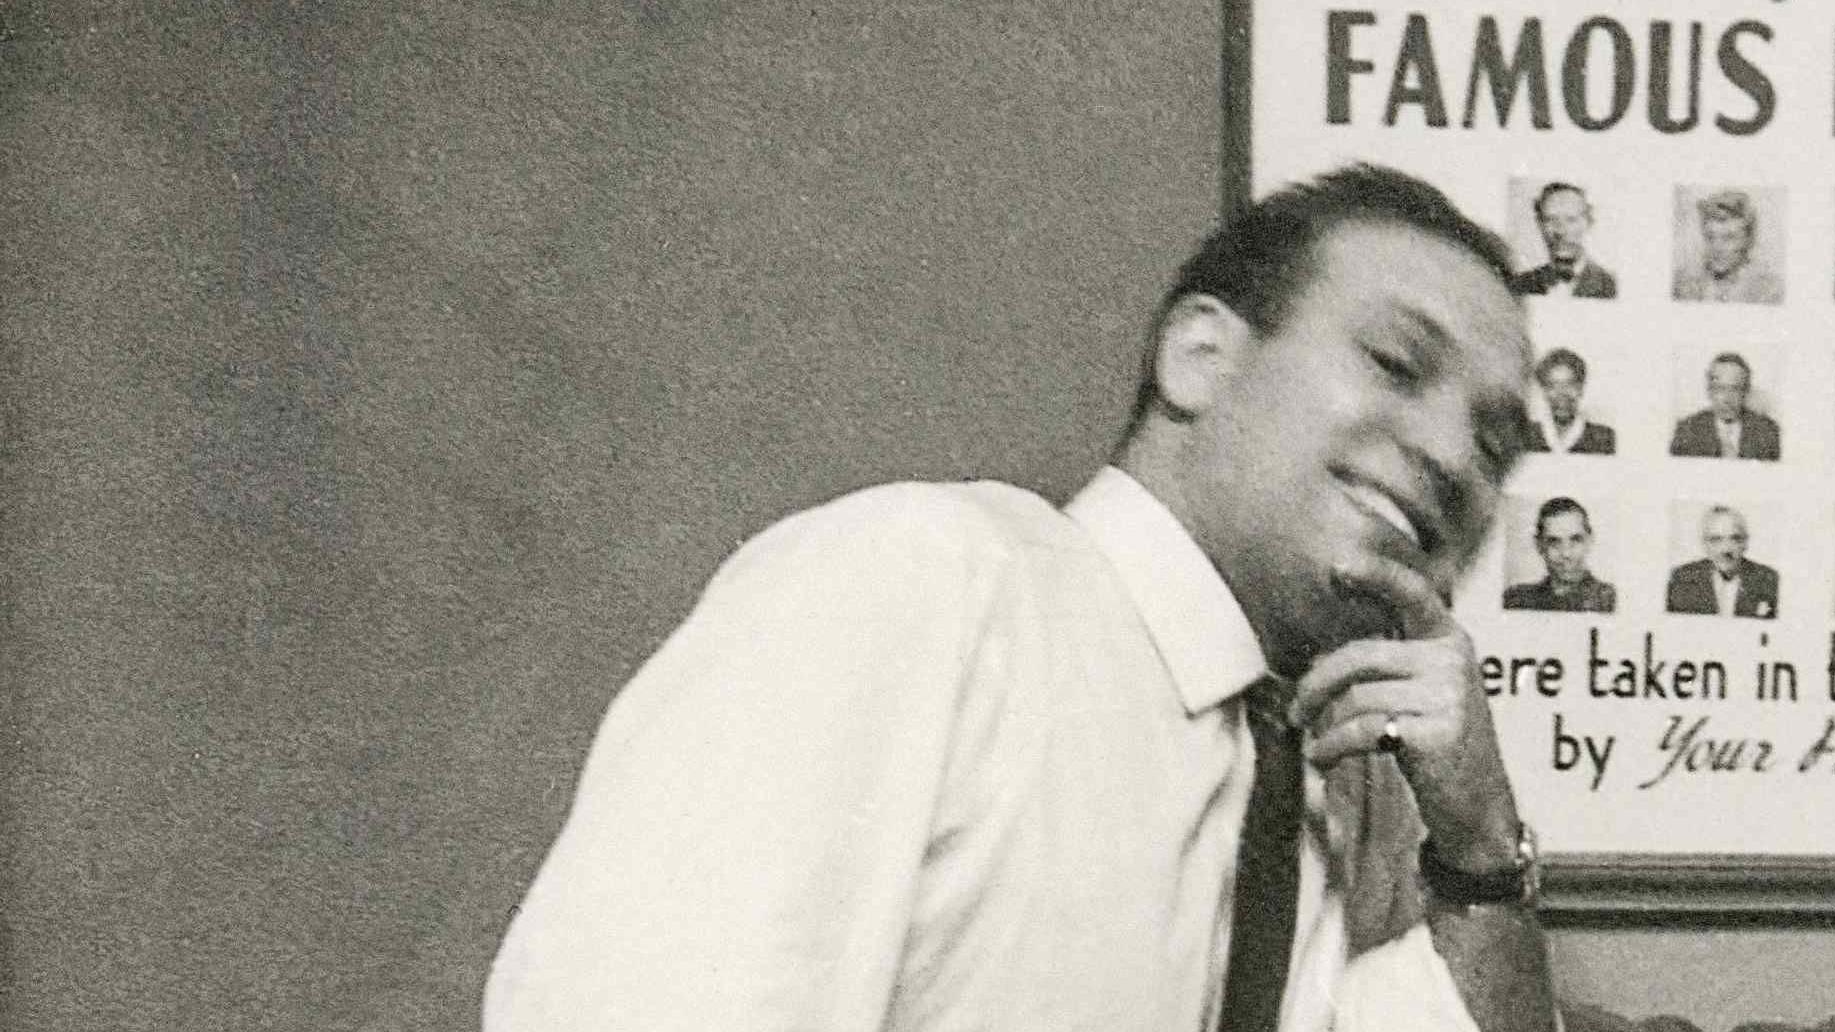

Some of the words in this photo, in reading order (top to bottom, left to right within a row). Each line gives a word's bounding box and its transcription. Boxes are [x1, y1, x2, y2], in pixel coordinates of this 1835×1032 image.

[1325, 9, 1778, 138] FAMOUS
[1480, 655, 1565, 698] ere
[1588, 627, 1728, 701] taken
[1756, 634, 1799, 703] in
[1552, 713, 1617, 792] by
[1636, 714, 1774, 791] Your
